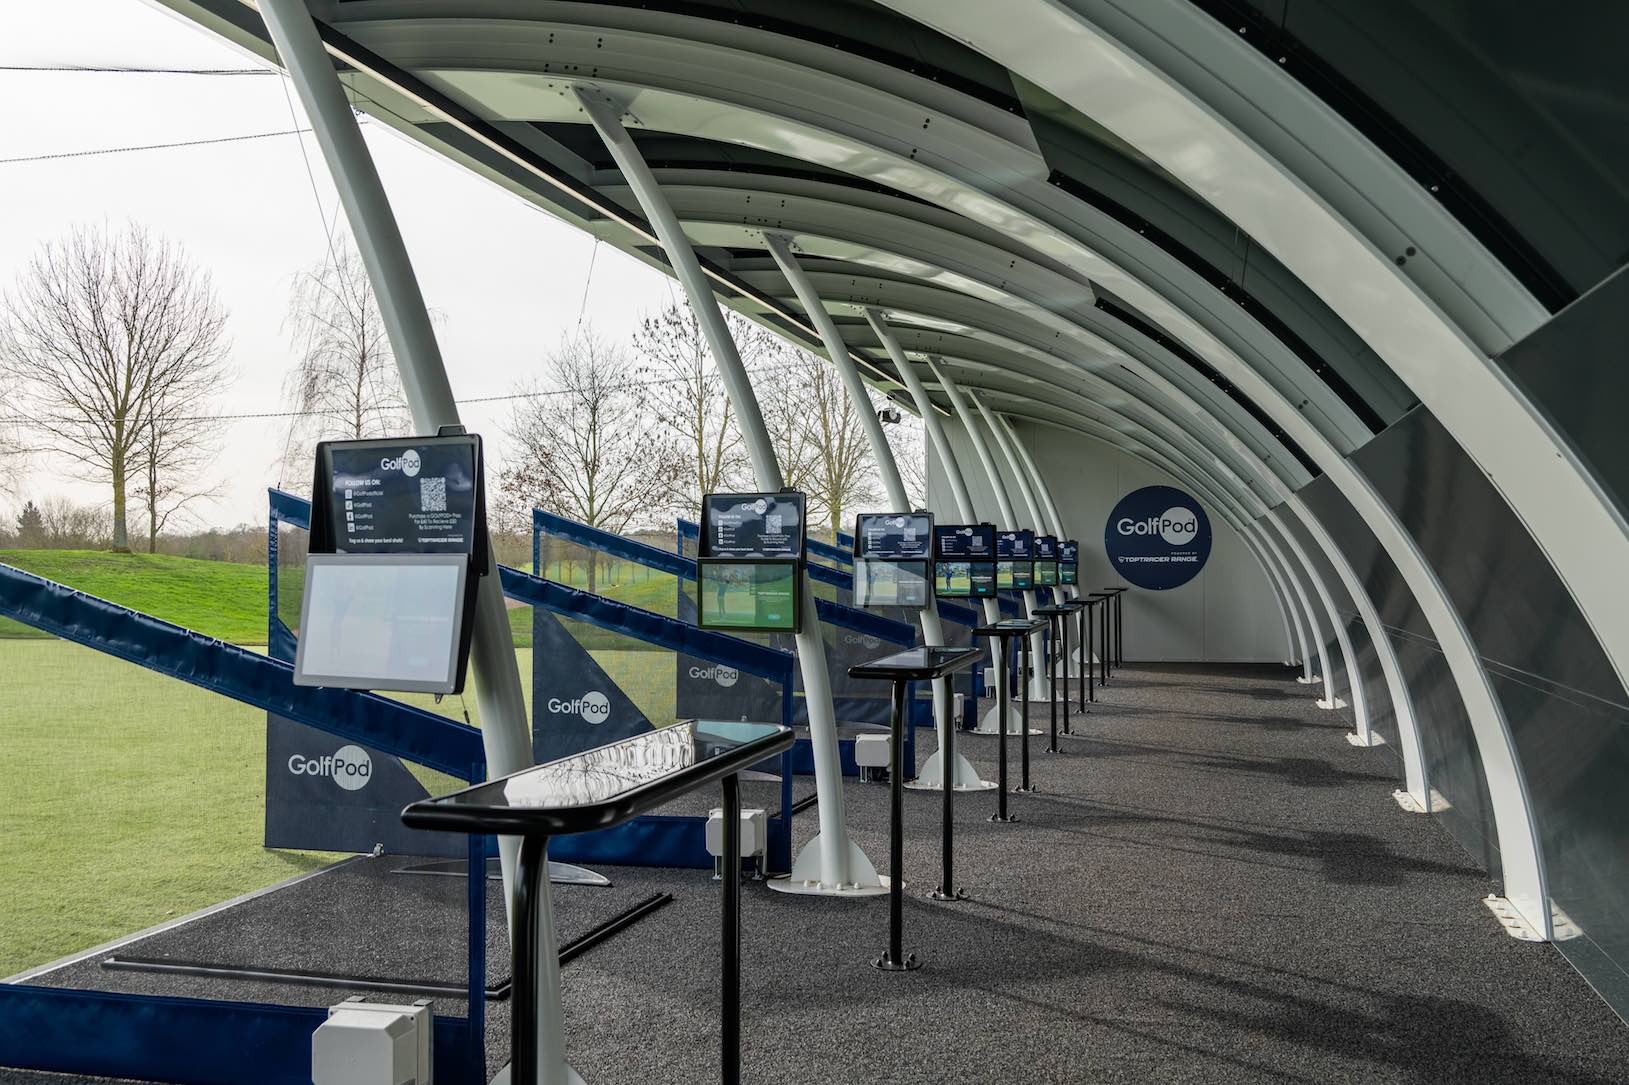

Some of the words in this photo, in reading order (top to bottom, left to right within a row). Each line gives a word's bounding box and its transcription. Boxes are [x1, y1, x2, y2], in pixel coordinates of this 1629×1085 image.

[381, 457, 420, 470] GolfPod
[1117, 518, 1196, 536] GolfPod
[689, 666, 737, 680] GolfPod
[548, 698, 609, 714] GolfPod
[288, 754, 370, 777] GolfPod
